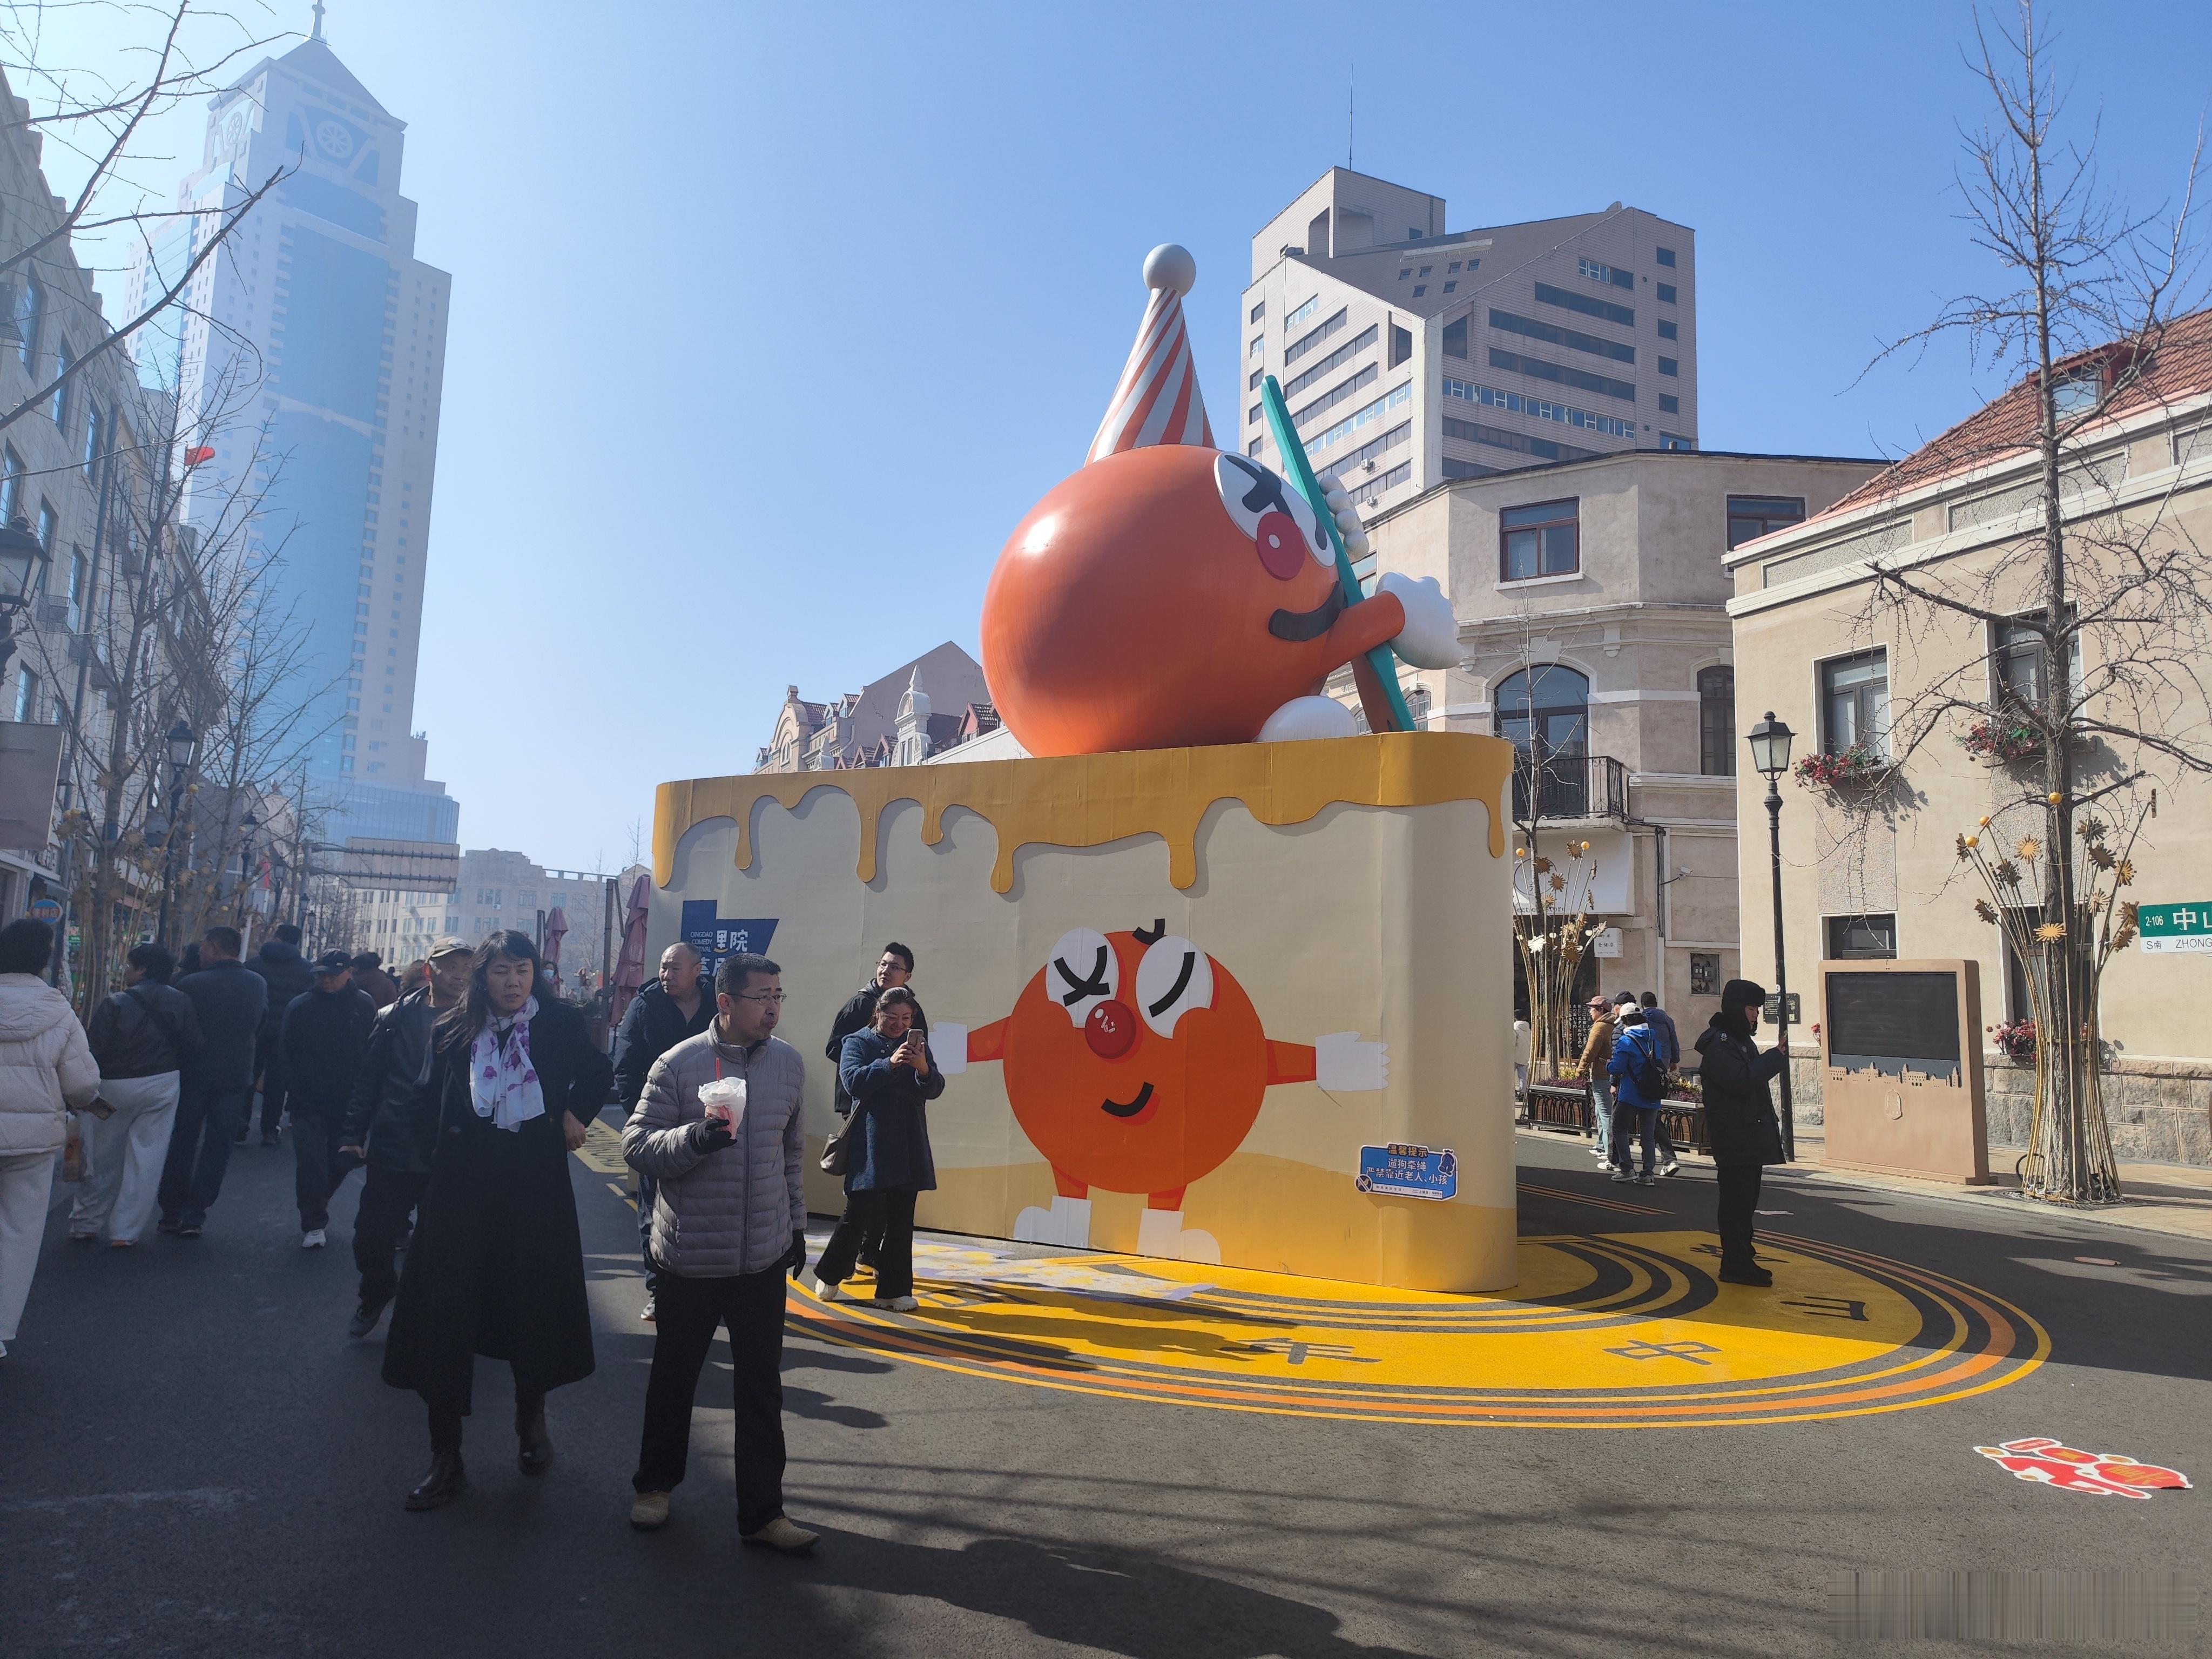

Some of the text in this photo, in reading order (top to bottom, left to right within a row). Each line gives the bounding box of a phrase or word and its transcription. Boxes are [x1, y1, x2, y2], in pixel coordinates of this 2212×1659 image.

[2145, 915, 2163, 926] 2-106
[713, 929, 748, 953] 里院
[2175, 938, 2212, 948] ZHONG
[1388, 1144, 1428, 1157] 温馨提示
[1388, 1158, 1426, 1171] 遛狗牵绳
[1367, 1166, 1448, 1185] 严禁靠近老人、小孩
